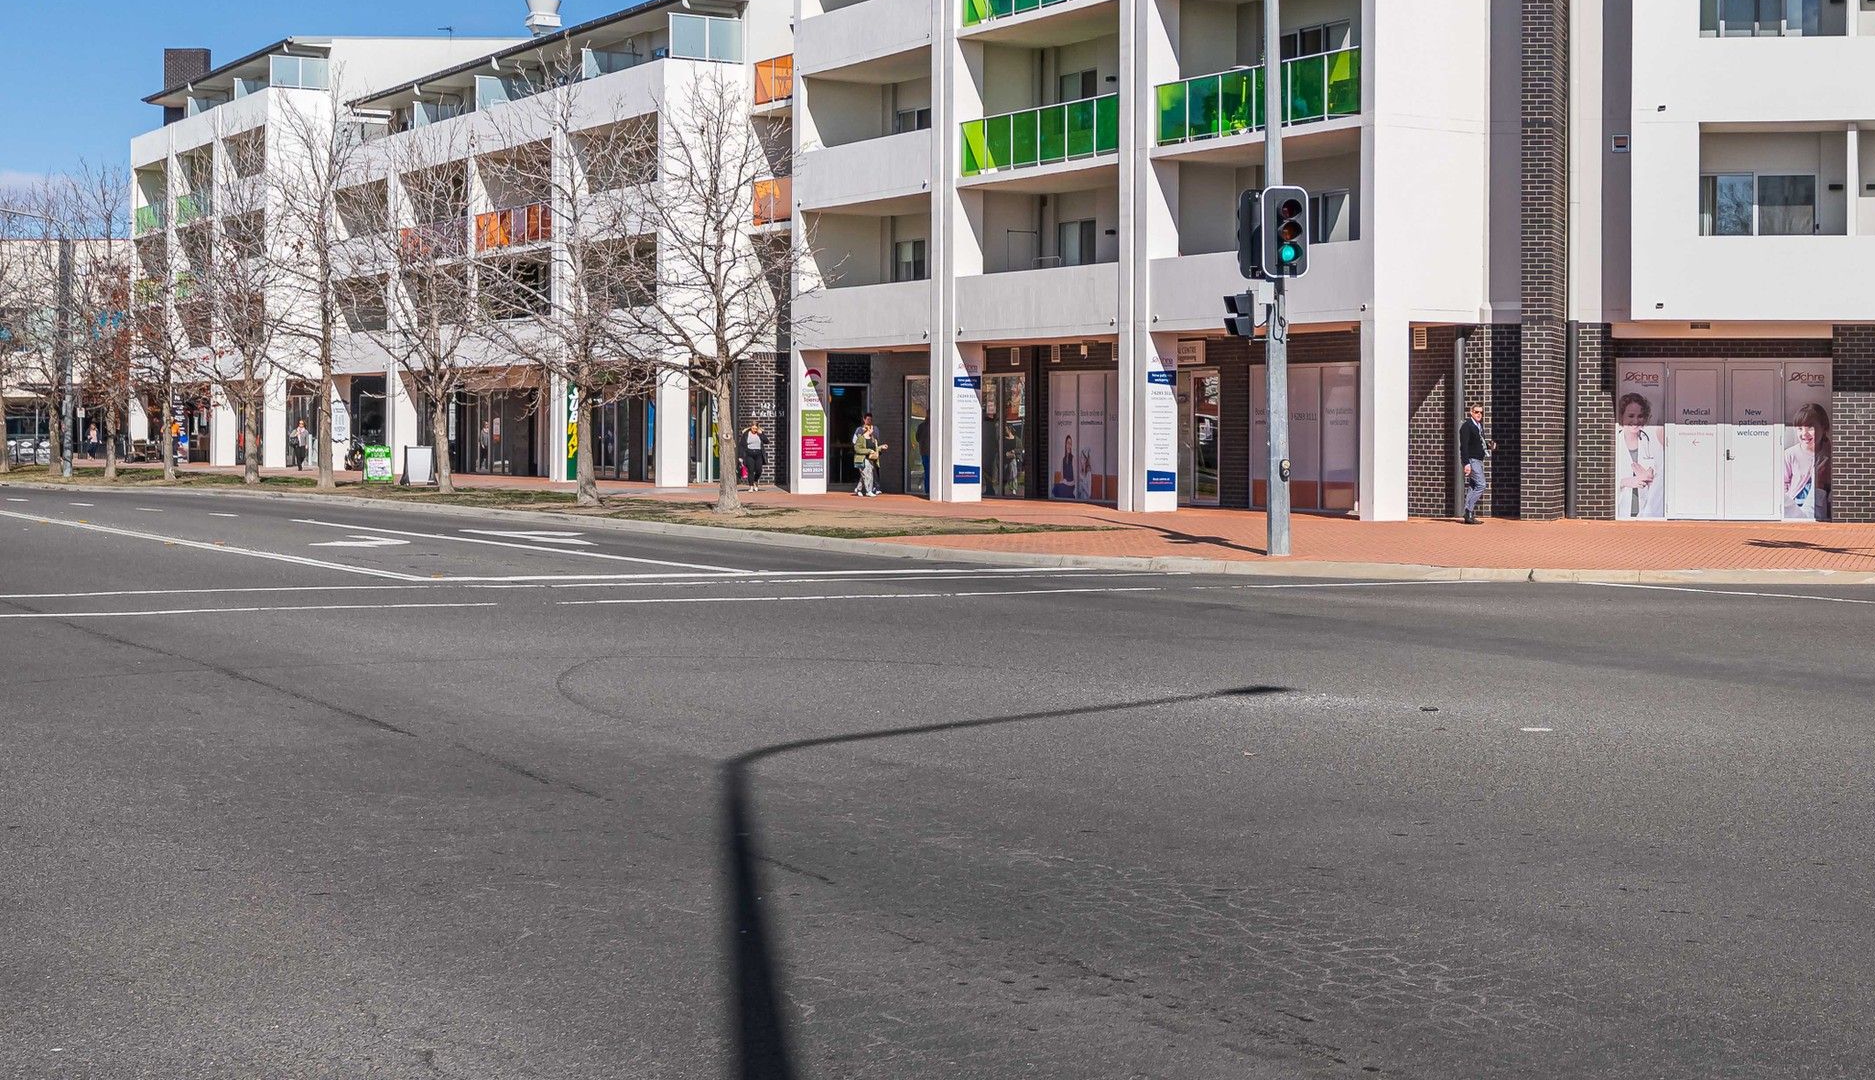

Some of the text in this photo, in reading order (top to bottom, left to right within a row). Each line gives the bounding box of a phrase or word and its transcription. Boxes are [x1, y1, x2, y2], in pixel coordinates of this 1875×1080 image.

[1682, 408, 1711, 416] Medical
[1744, 408, 1762, 416] New
[1684, 418, 1709, 426] Centre
[1738, 418, 1768, 427] patients
[1736, 429, 1770, 437] welcome
